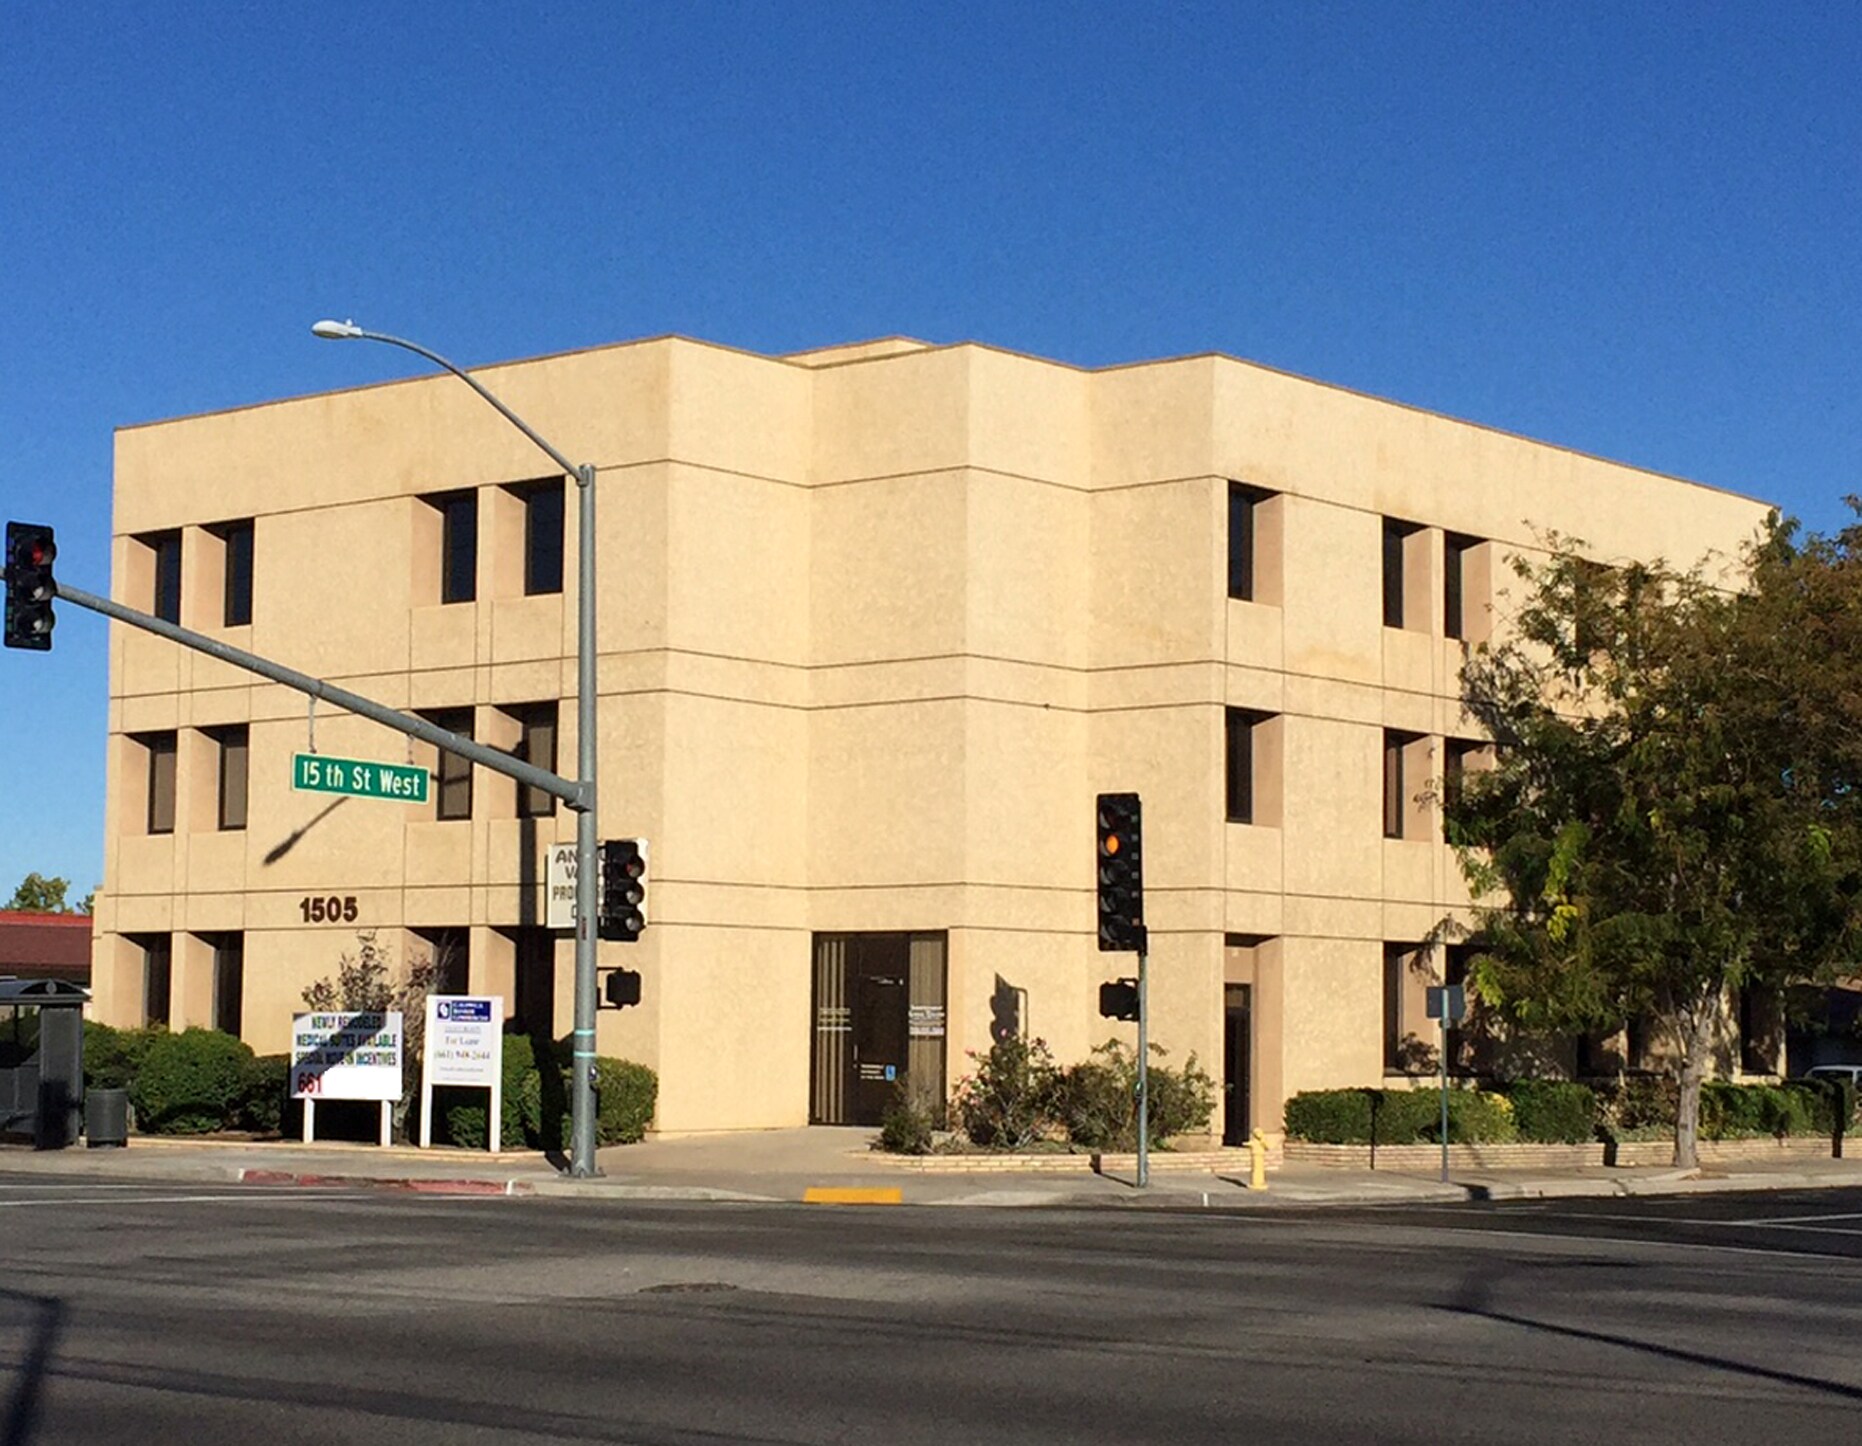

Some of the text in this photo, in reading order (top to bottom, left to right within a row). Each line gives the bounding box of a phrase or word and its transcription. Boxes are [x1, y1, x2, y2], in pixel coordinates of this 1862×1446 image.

[303, 761, 420, 796] 15 th St West
[299, 895, 358, 923] 1505
[311, 1015, 336, 1029] NEWLY
[296, 1033, 328, 1047] MEDICAL
[357, 1033, 396, 1047] AVAILABLE
[356, 1051, 396, 1065] INCENTIVES
[298, 1072, 322, 1093] 661
